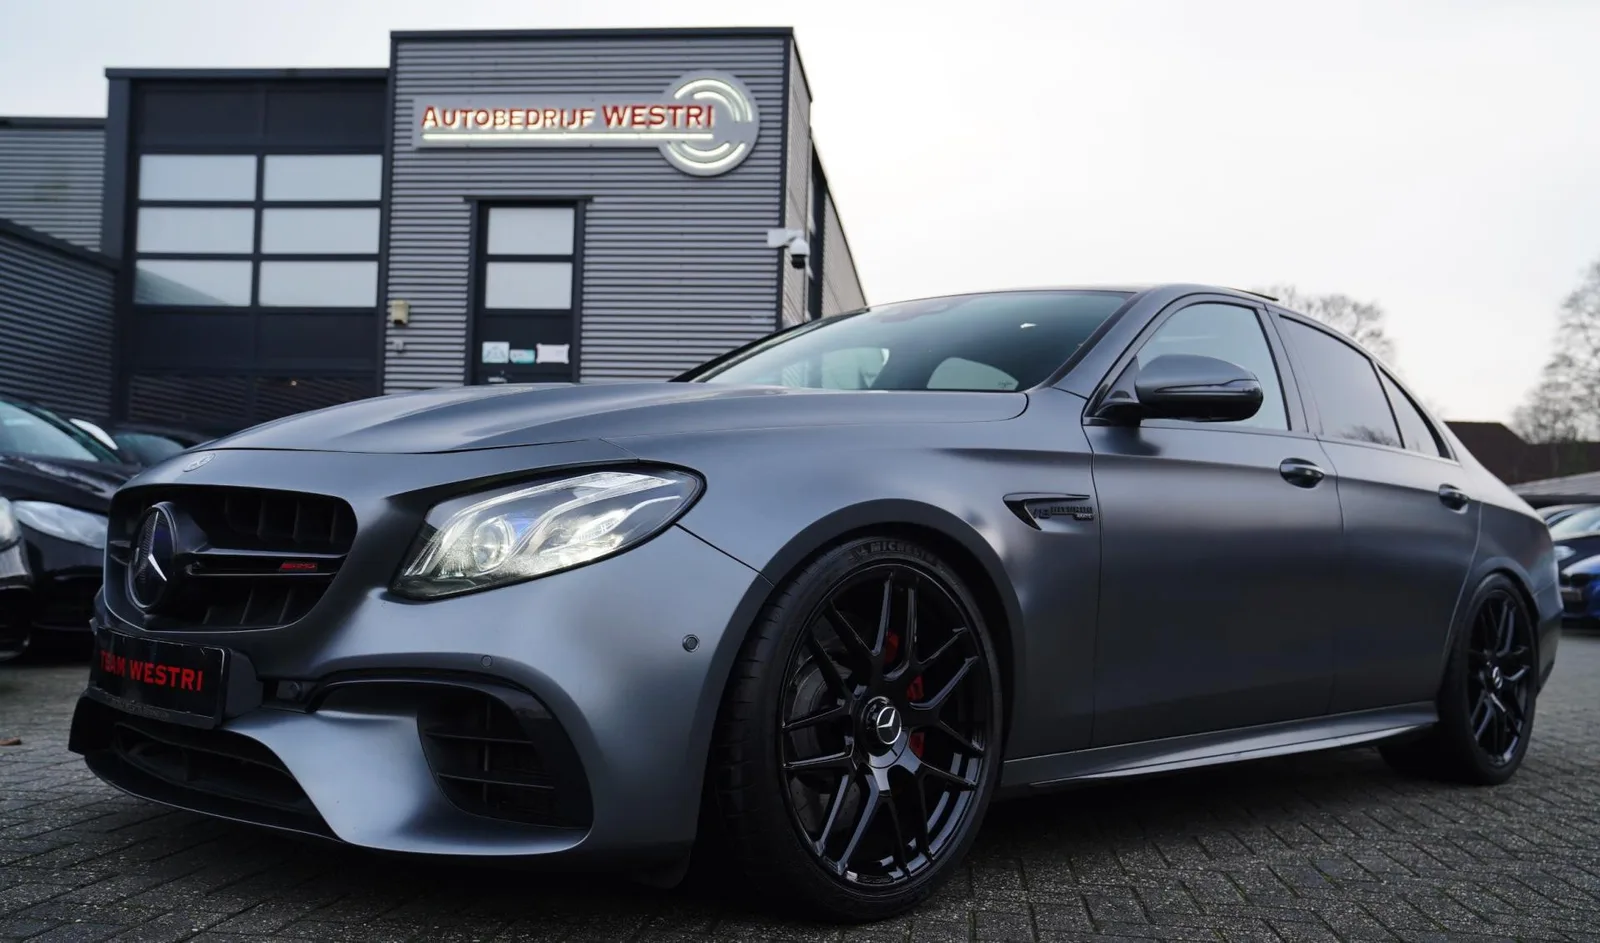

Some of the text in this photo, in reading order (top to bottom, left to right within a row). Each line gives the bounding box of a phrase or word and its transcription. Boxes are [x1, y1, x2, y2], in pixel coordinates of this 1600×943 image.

[602, 105, 714, 128] WESTRI
[870, 541, 937, 562] MICHELIN
[100, 650, 204, 691] TEAM WESTRI
